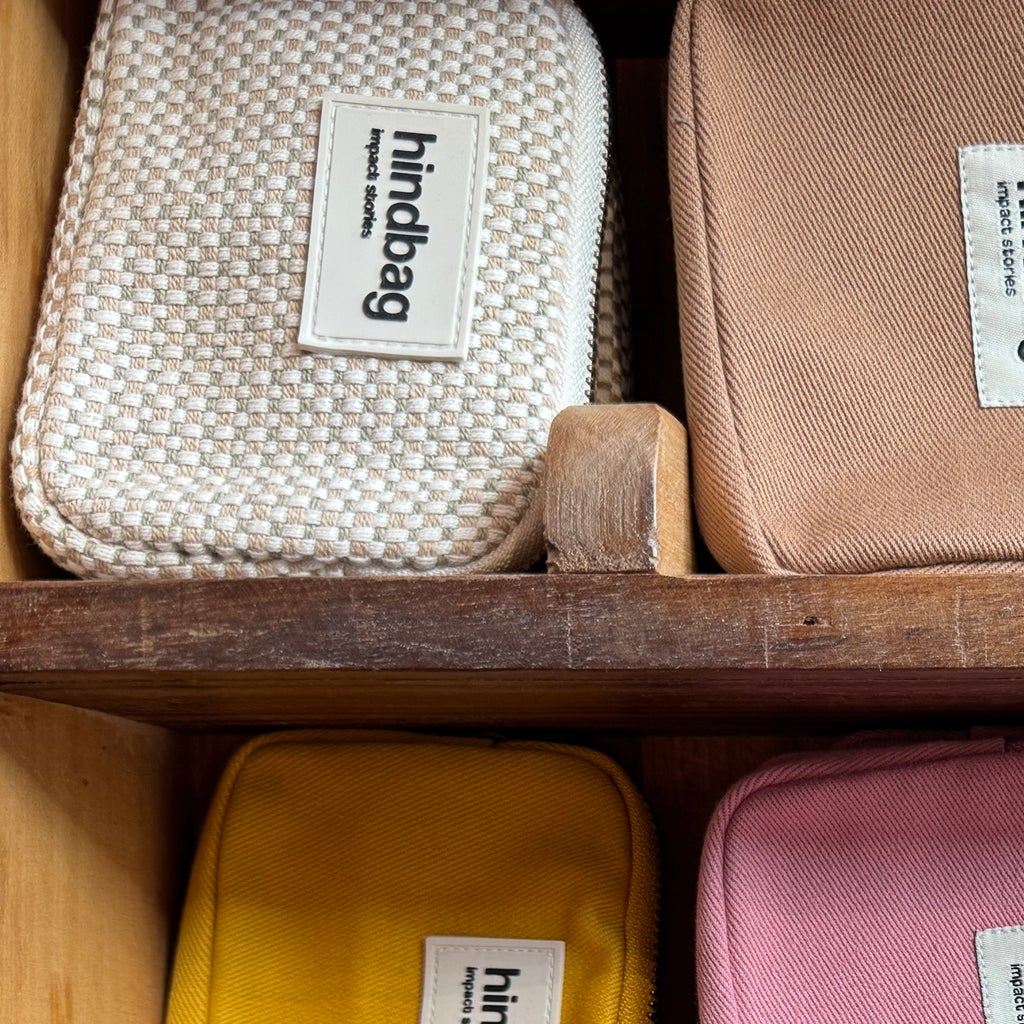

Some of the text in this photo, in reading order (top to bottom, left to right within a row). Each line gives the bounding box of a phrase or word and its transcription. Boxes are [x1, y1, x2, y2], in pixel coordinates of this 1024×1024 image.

[361, 128, 385, 239] impact stories
[361, 130, 438, 323] hindbag
[995, 180, 1017, 298] impact stories
[460, 966, 479, 1014] impact
